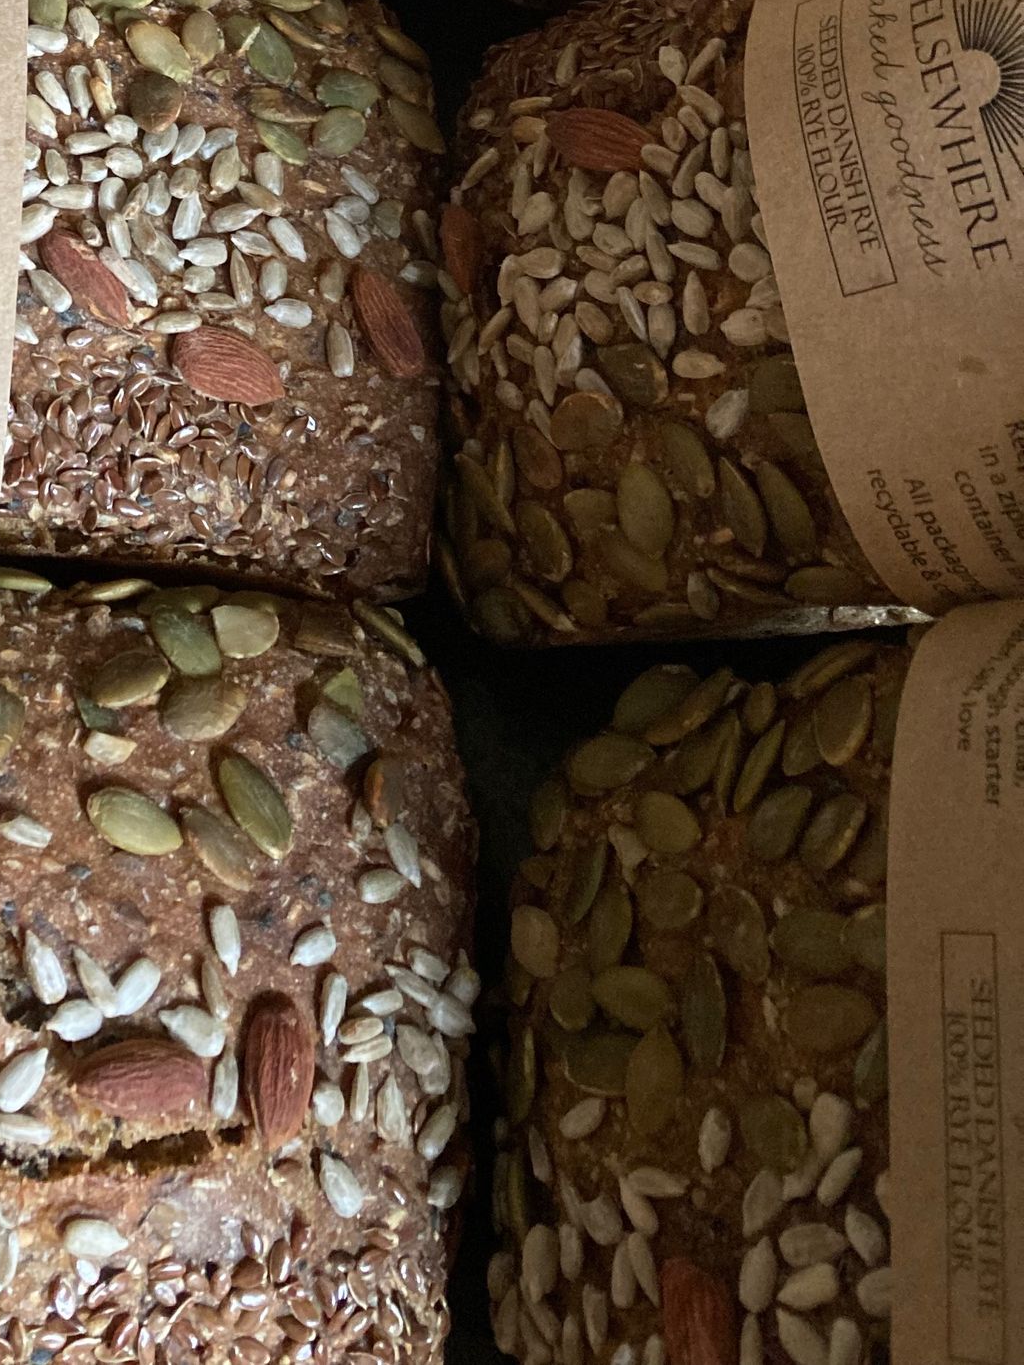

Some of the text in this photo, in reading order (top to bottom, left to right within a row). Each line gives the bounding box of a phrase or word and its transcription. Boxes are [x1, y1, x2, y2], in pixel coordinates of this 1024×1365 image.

[796, 43, 846, 233] 100% RYE FLOUR
[819, 15, 881, 254] SEEDED DANISH RYE
[861, 91, 947, 277] goodness
[904, 479, 933, 505] All
[978, 445, 1006, 486] in a
[867, 469, 941, 582] recyclable &
[954, 471, 1015, 564] container
[958, 702, 976, 752] love
[985, 725, 1002, 807] starter
